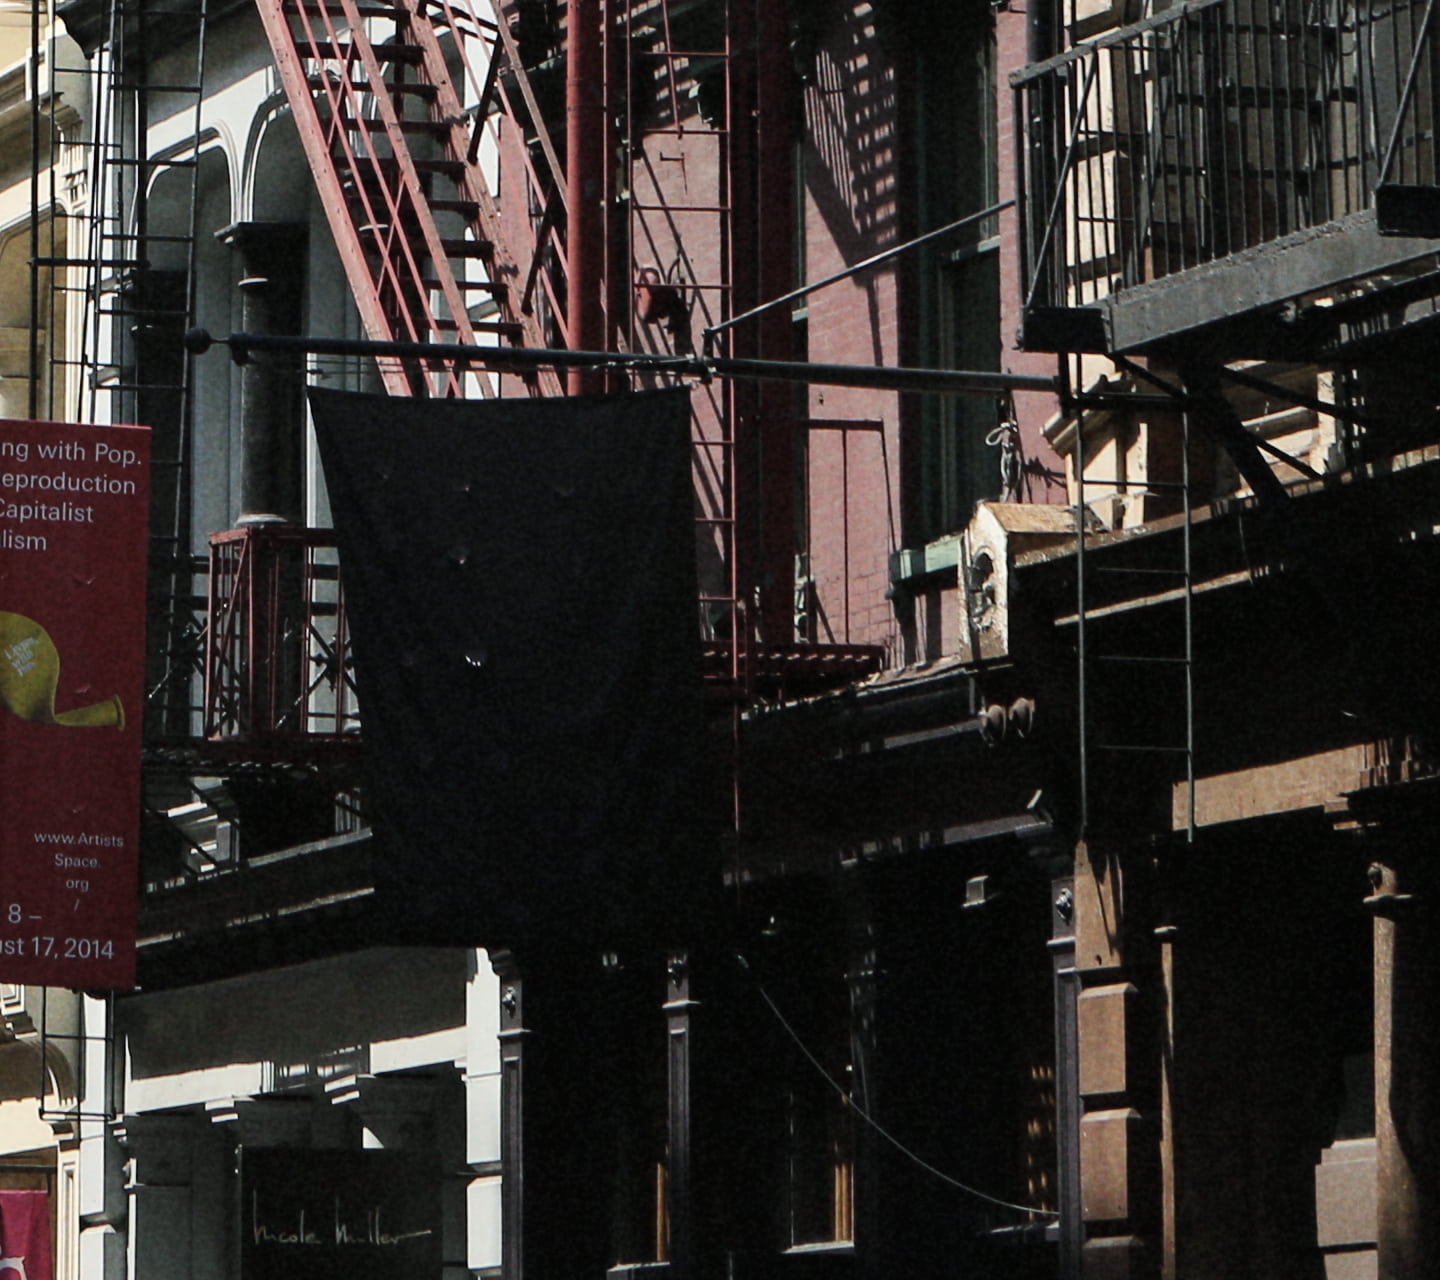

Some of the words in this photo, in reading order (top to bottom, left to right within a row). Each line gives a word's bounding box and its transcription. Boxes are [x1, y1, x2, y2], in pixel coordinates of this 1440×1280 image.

[37, 441, 86, 462] with
[95, 442, 142, 468] Pop.
[34, 832, 125, 848] www.Artists
[65, 878, 89, 893] org
[7, 903, 23, 924] 8
[31, 936, 58, 960] 17,
[64, 939, 115, 960] 2014
